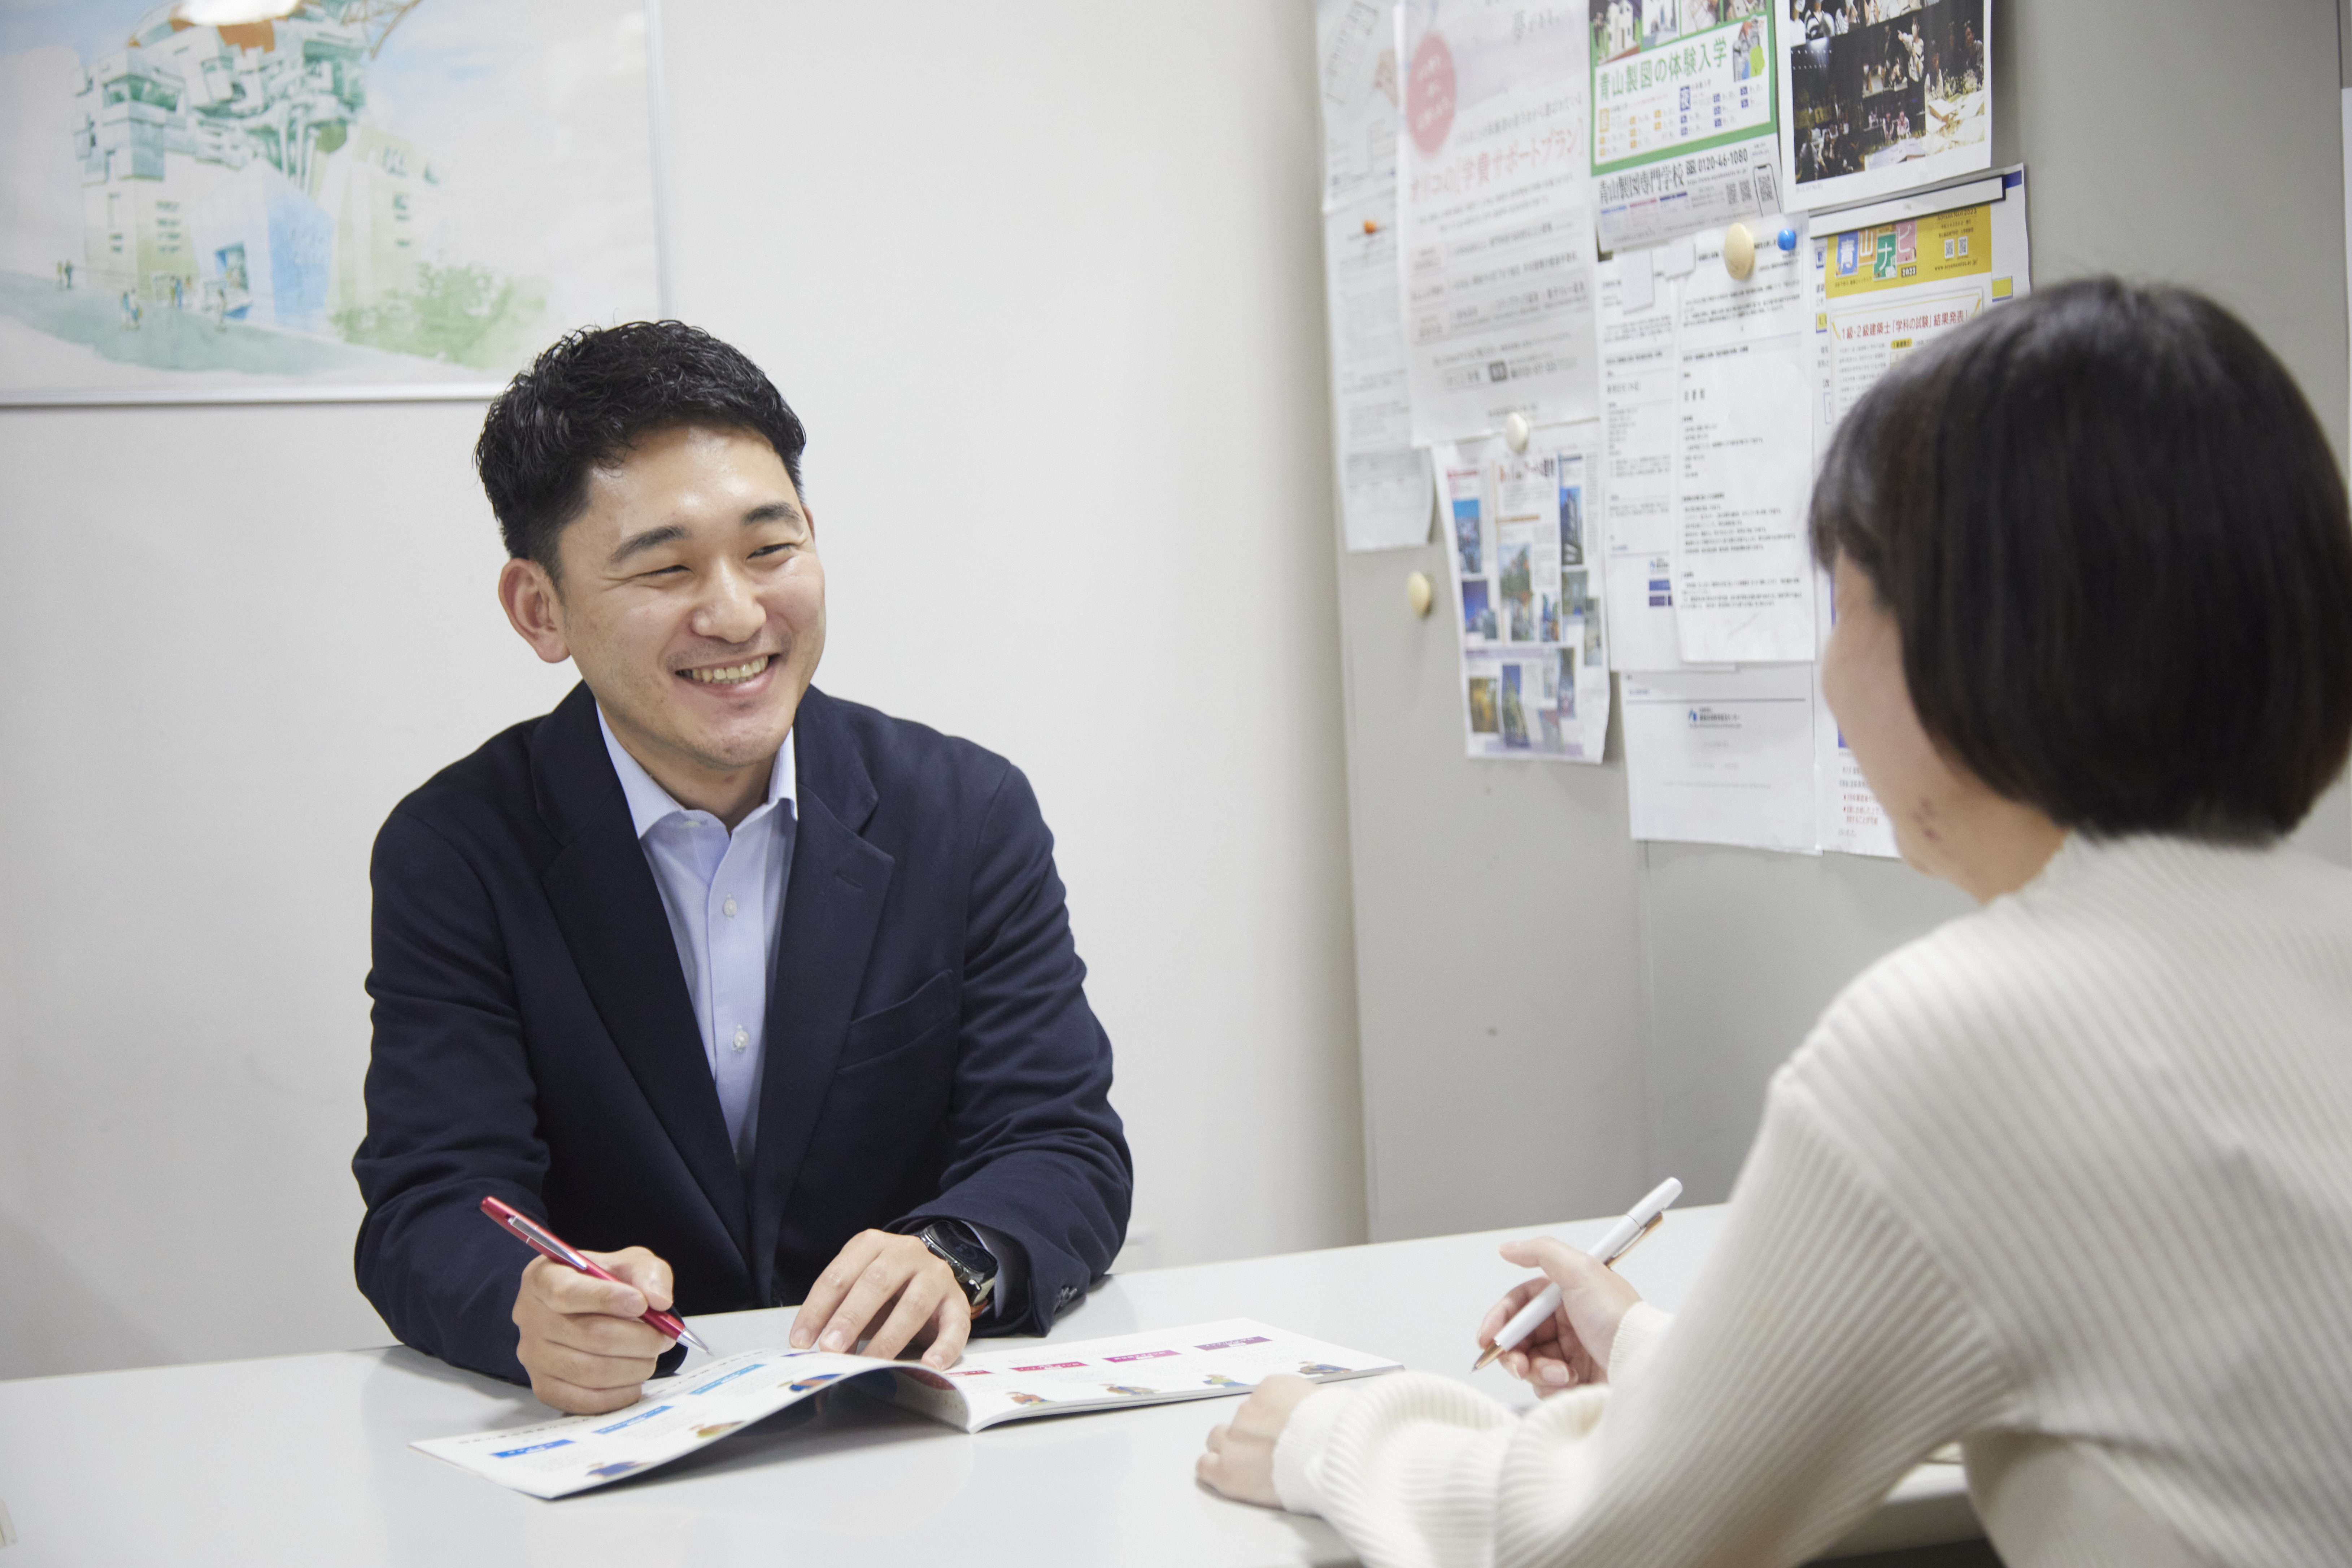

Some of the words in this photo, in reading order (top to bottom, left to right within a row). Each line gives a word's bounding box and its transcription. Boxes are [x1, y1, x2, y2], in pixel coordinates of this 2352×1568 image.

[1600, 36, 1727, 101] 青山製図の体験入学
[1698, 148, 1748, 172] 0120-46-1080
[1600, 162, 1685, 205] 青山製図専門学校
[1902, 266, 1917, 278] 2023
